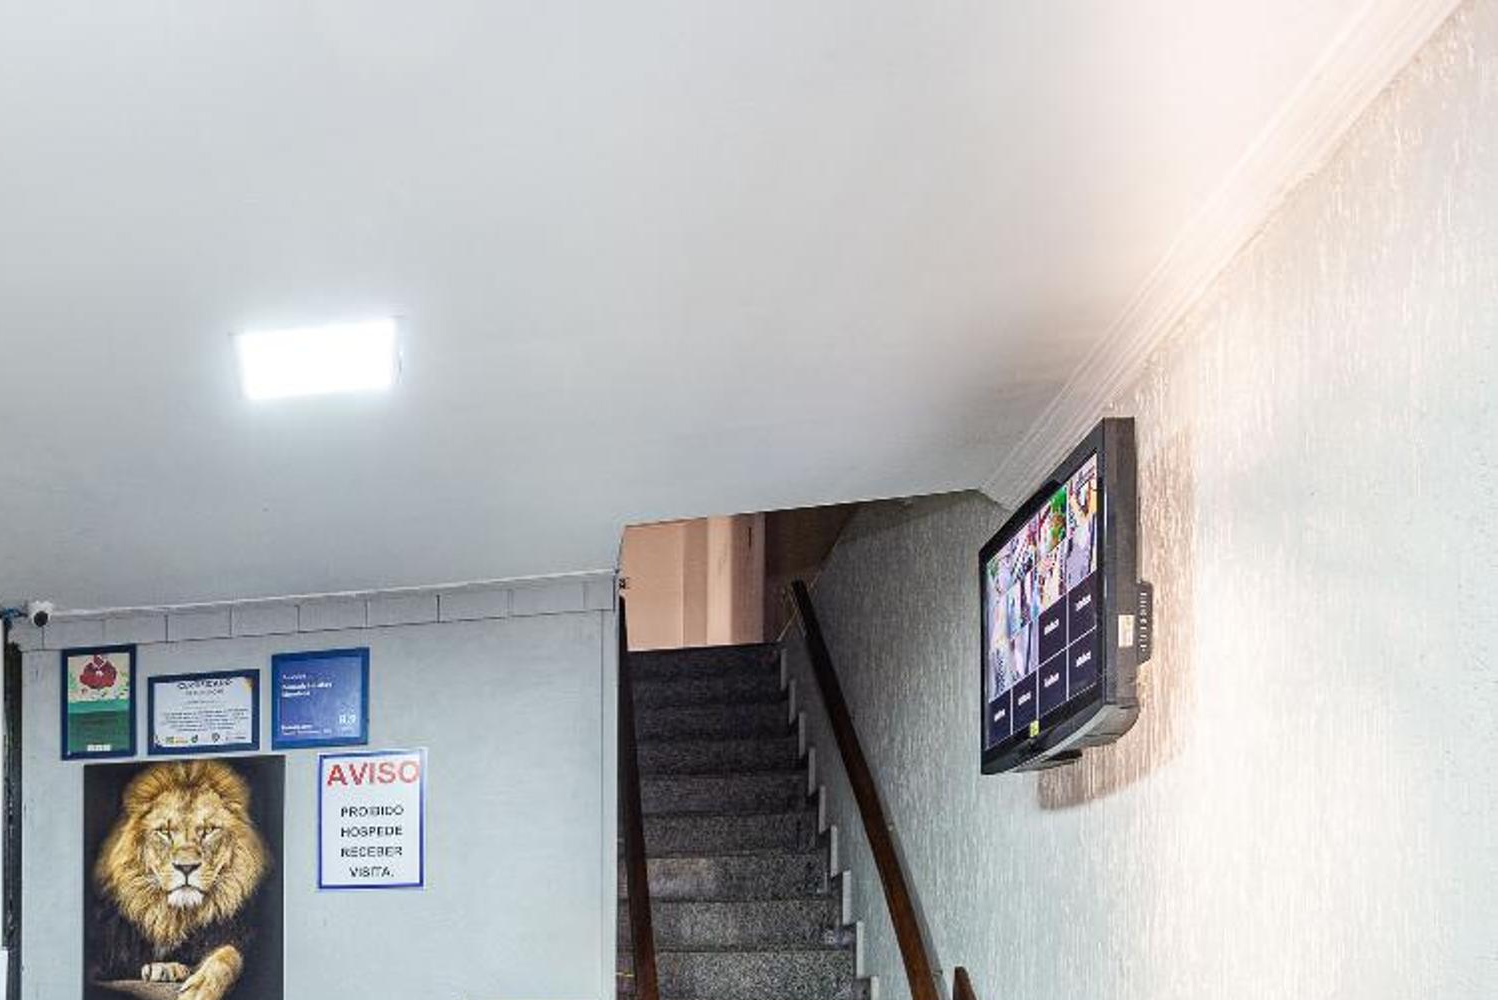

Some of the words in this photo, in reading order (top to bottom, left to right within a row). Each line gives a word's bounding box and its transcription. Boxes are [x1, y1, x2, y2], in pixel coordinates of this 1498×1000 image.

[326, 760, 421, 786] AVISO
[340, 804, 405, 818] PROIBIDO
[340, 825, 404, 838] HOSPEDE
[340, 845, 403, 858] RECEBER
[349, 865, 395, 878] VISITA.
